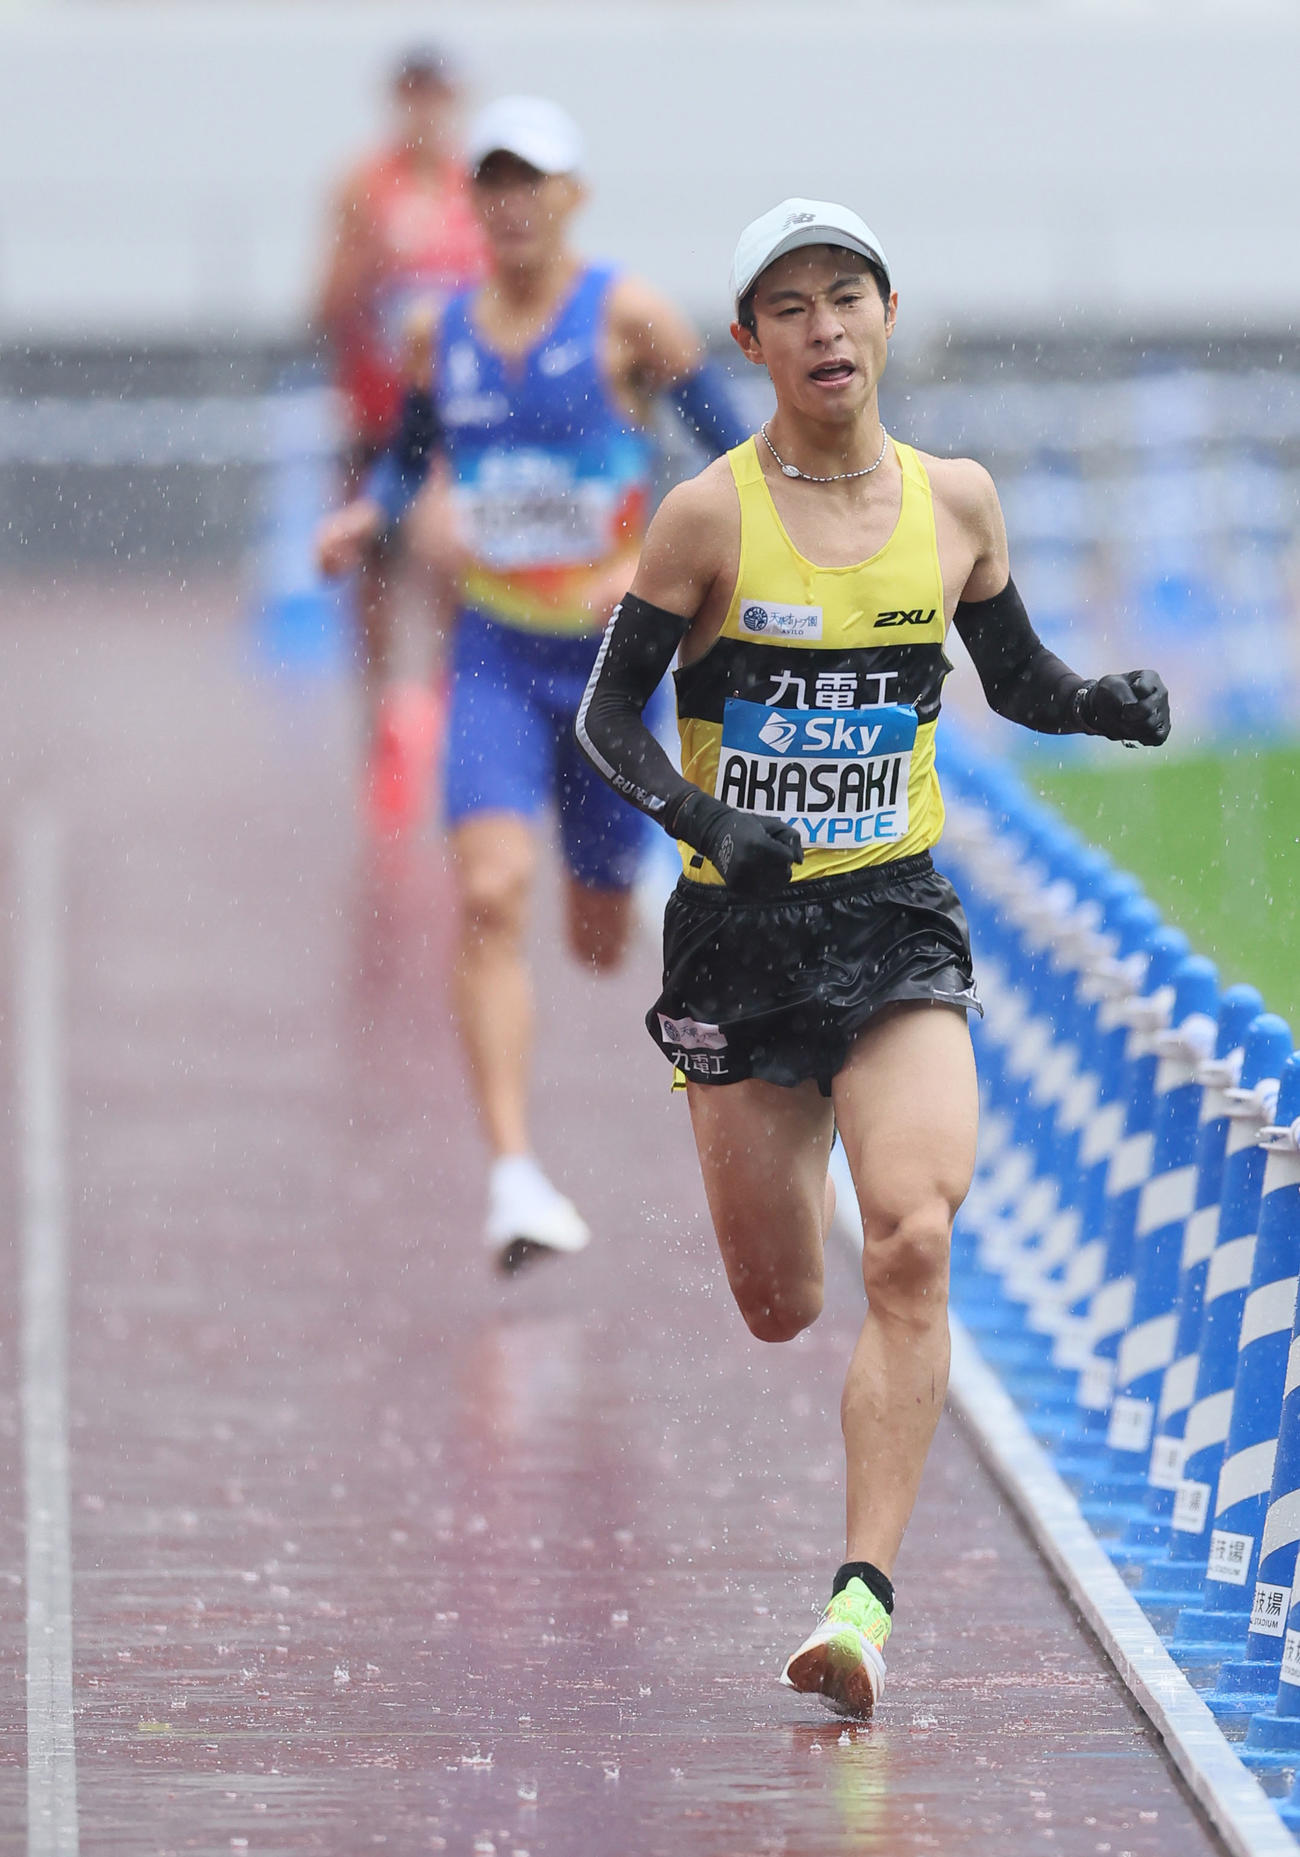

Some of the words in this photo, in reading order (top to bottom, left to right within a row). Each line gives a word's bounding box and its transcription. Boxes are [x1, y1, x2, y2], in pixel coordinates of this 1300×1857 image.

[873, 609, 936, 628] 2XU
[765, 670, 899, 710] 九電工
[802, 717, 883, 755] Sky
[720, 754, 902, 812] AKASAKI
[671, 1049, 729, 1075] 九電工
